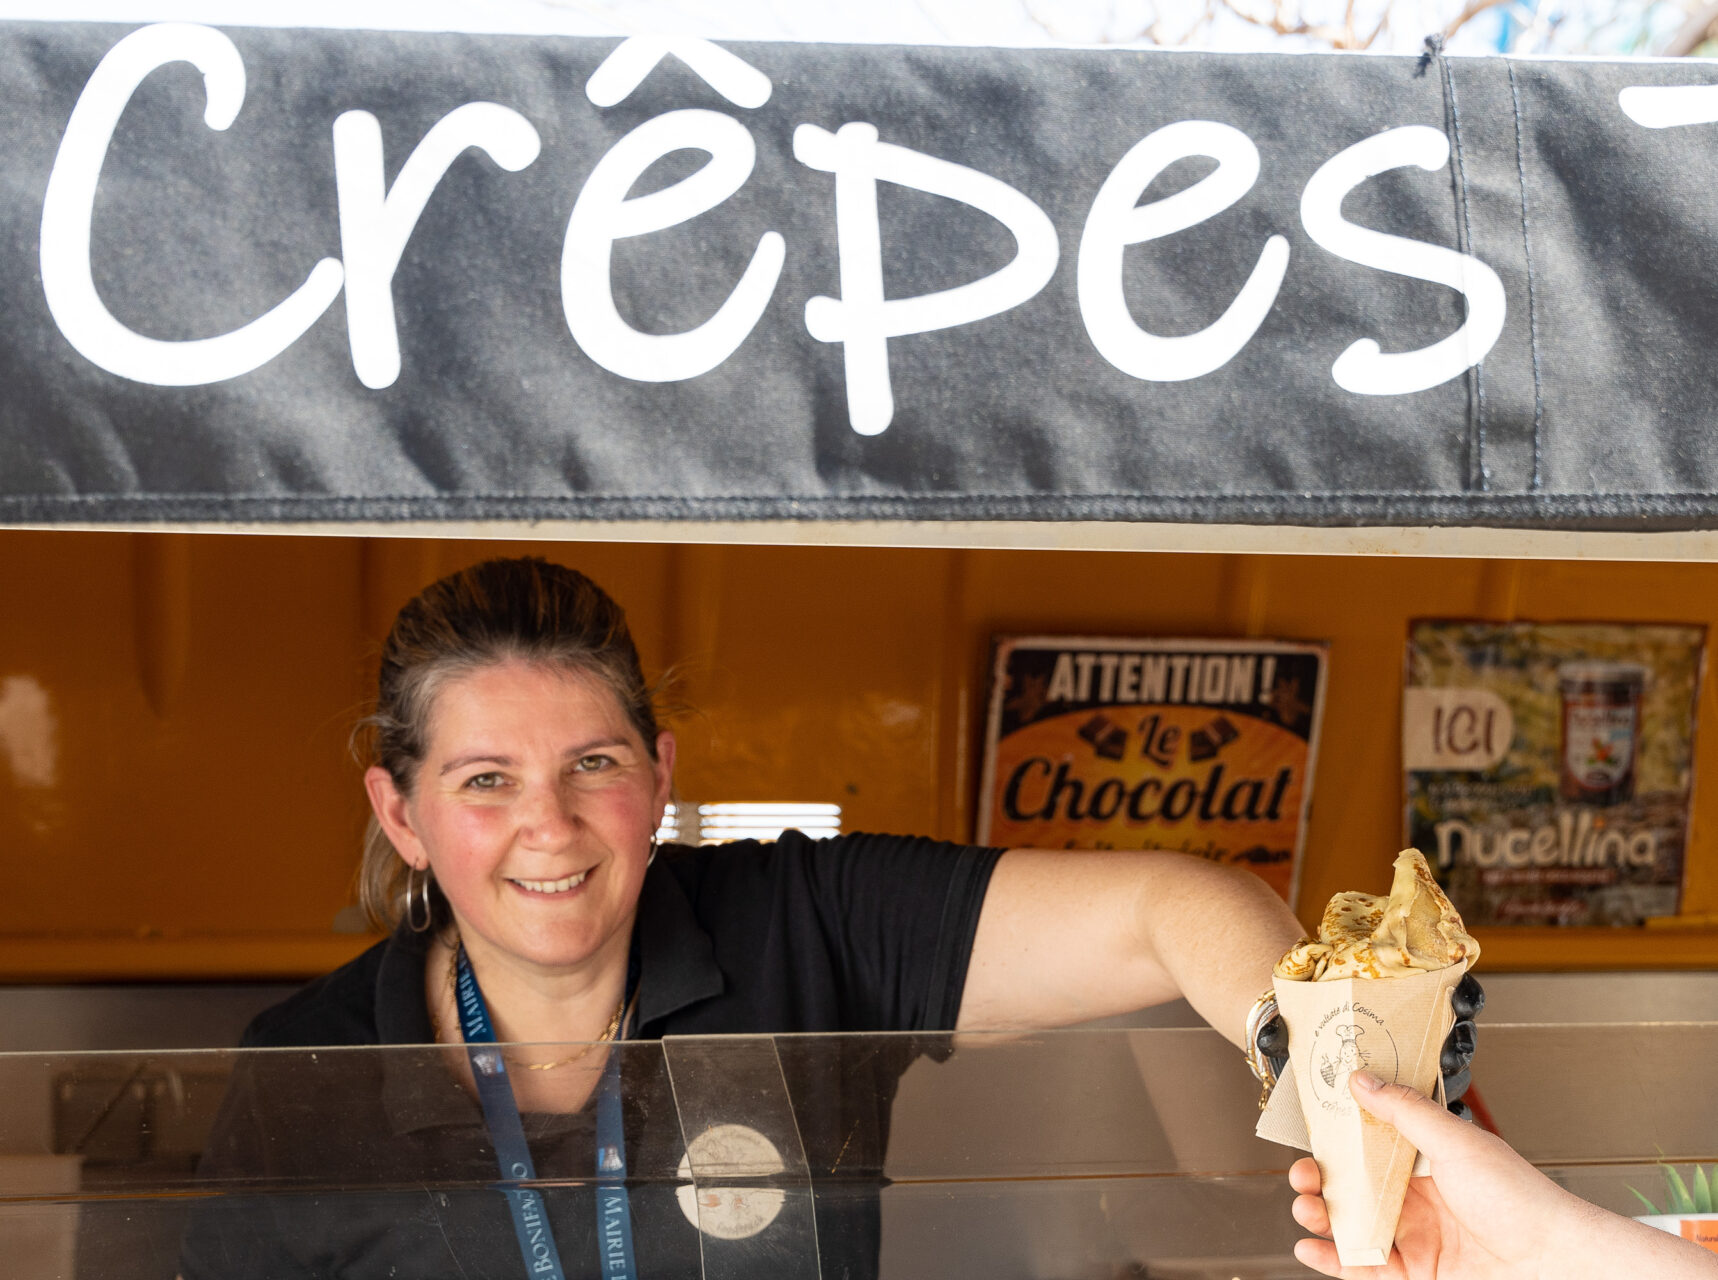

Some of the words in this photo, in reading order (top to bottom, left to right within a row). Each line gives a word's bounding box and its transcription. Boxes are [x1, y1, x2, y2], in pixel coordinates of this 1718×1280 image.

[39, 22, 1506, 437] Crêpes
[1137, 713, 1182, 768] Le
[1432, 704, 1496, 756] ICI
[1003, 756, 1293, 822] Chocolat
[1352, 1001, 1385, 1026] Cosima
[603, 1196, 627, 1271] MAIRIE
